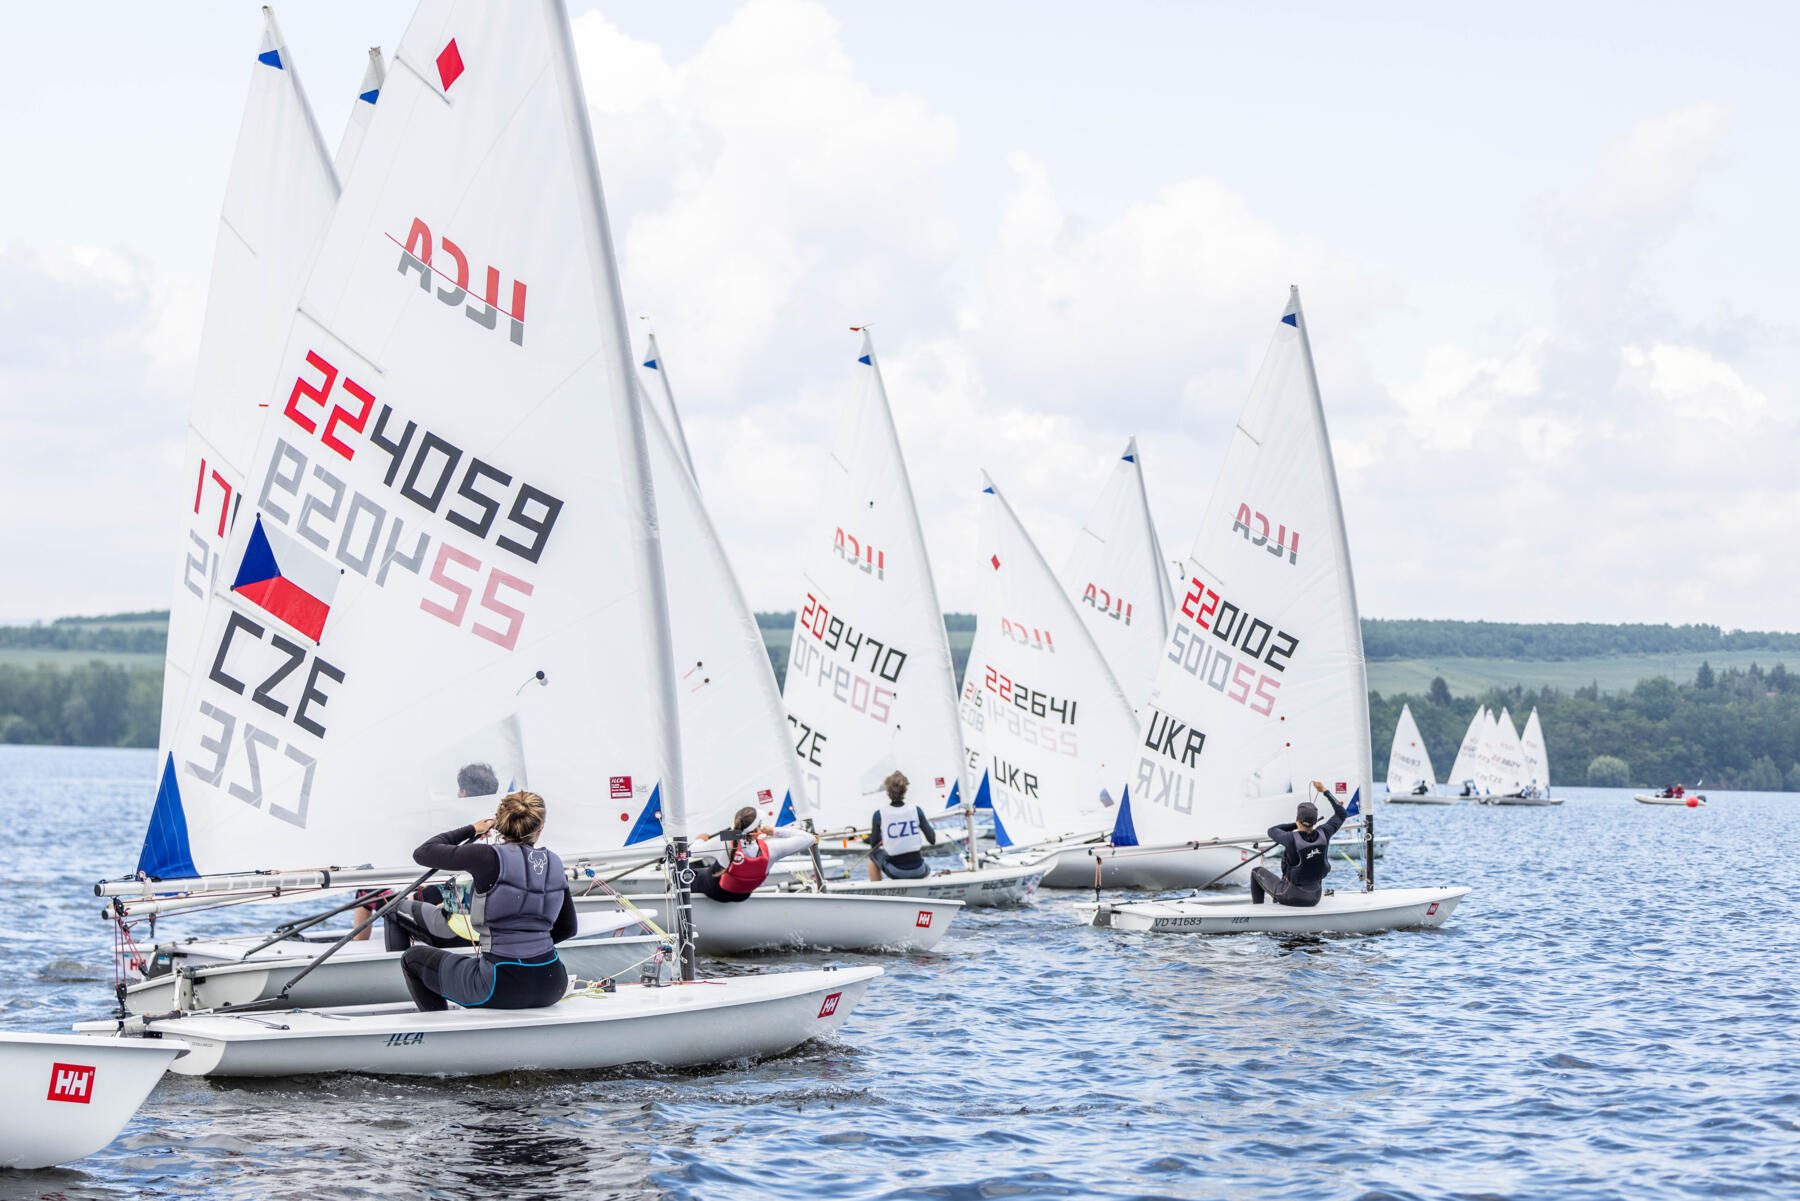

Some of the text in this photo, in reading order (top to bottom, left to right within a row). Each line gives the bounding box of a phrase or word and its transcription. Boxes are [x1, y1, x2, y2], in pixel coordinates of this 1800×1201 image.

[283, 349, 565, 565] 224059
[801, 592, 907, 683] 209470
[1181, 577, 1299, 672] 220102
[209, 610, 345, 739] CZE
[986, 665, 1077, 725] 222641
[1145, 711, 1206, 769] UKR
[994, 756, 1038, 799] UKR
[887, 820, 919, 838] CZE
[1154, 918, 1169, 927] VD
[820, 995, 840, 1015] HH
[386, 1032, 425, 1047] ILCA
[55, 1069, 90, 1097] HH
